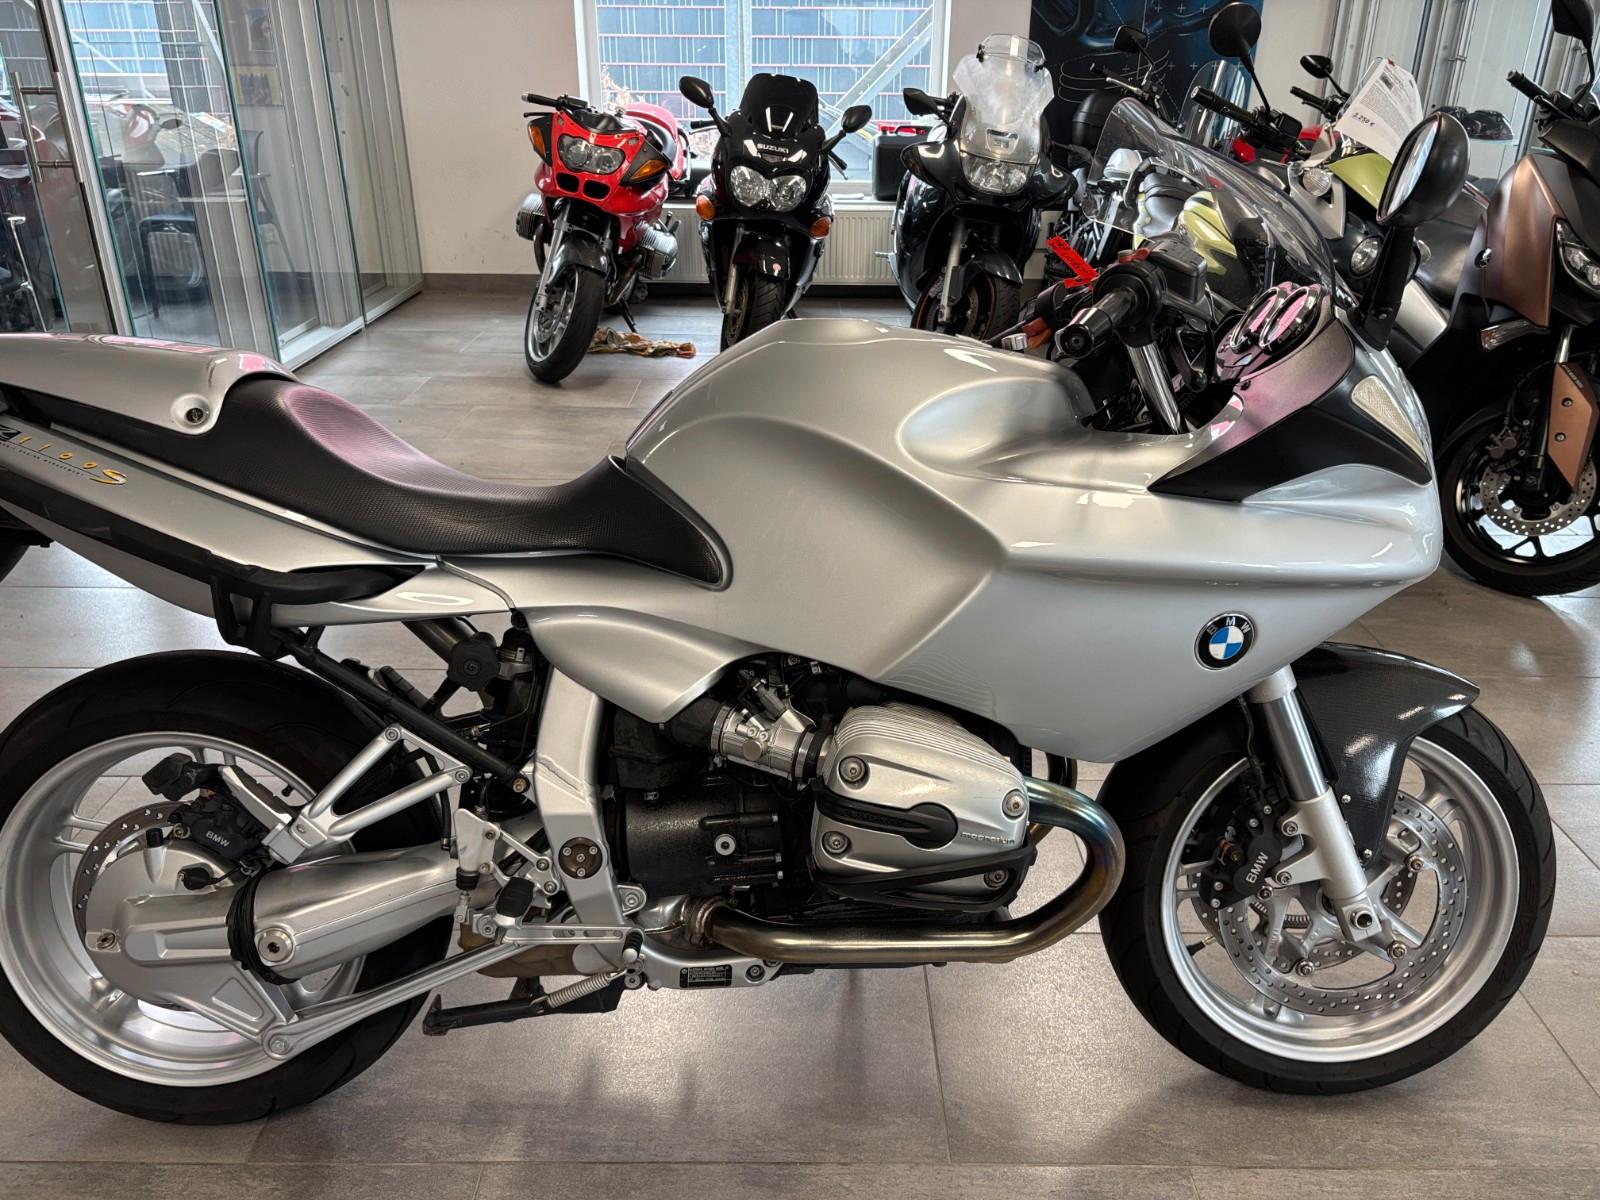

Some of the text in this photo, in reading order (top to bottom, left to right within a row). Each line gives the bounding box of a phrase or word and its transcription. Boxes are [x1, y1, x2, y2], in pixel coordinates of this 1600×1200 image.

[757, 143, 789, 154] SUZUKI
[1206, 616, 1251, 635] BMW
[206, 830, 231, 847] BMW
[1245, 851, 1269, 884] BMW
